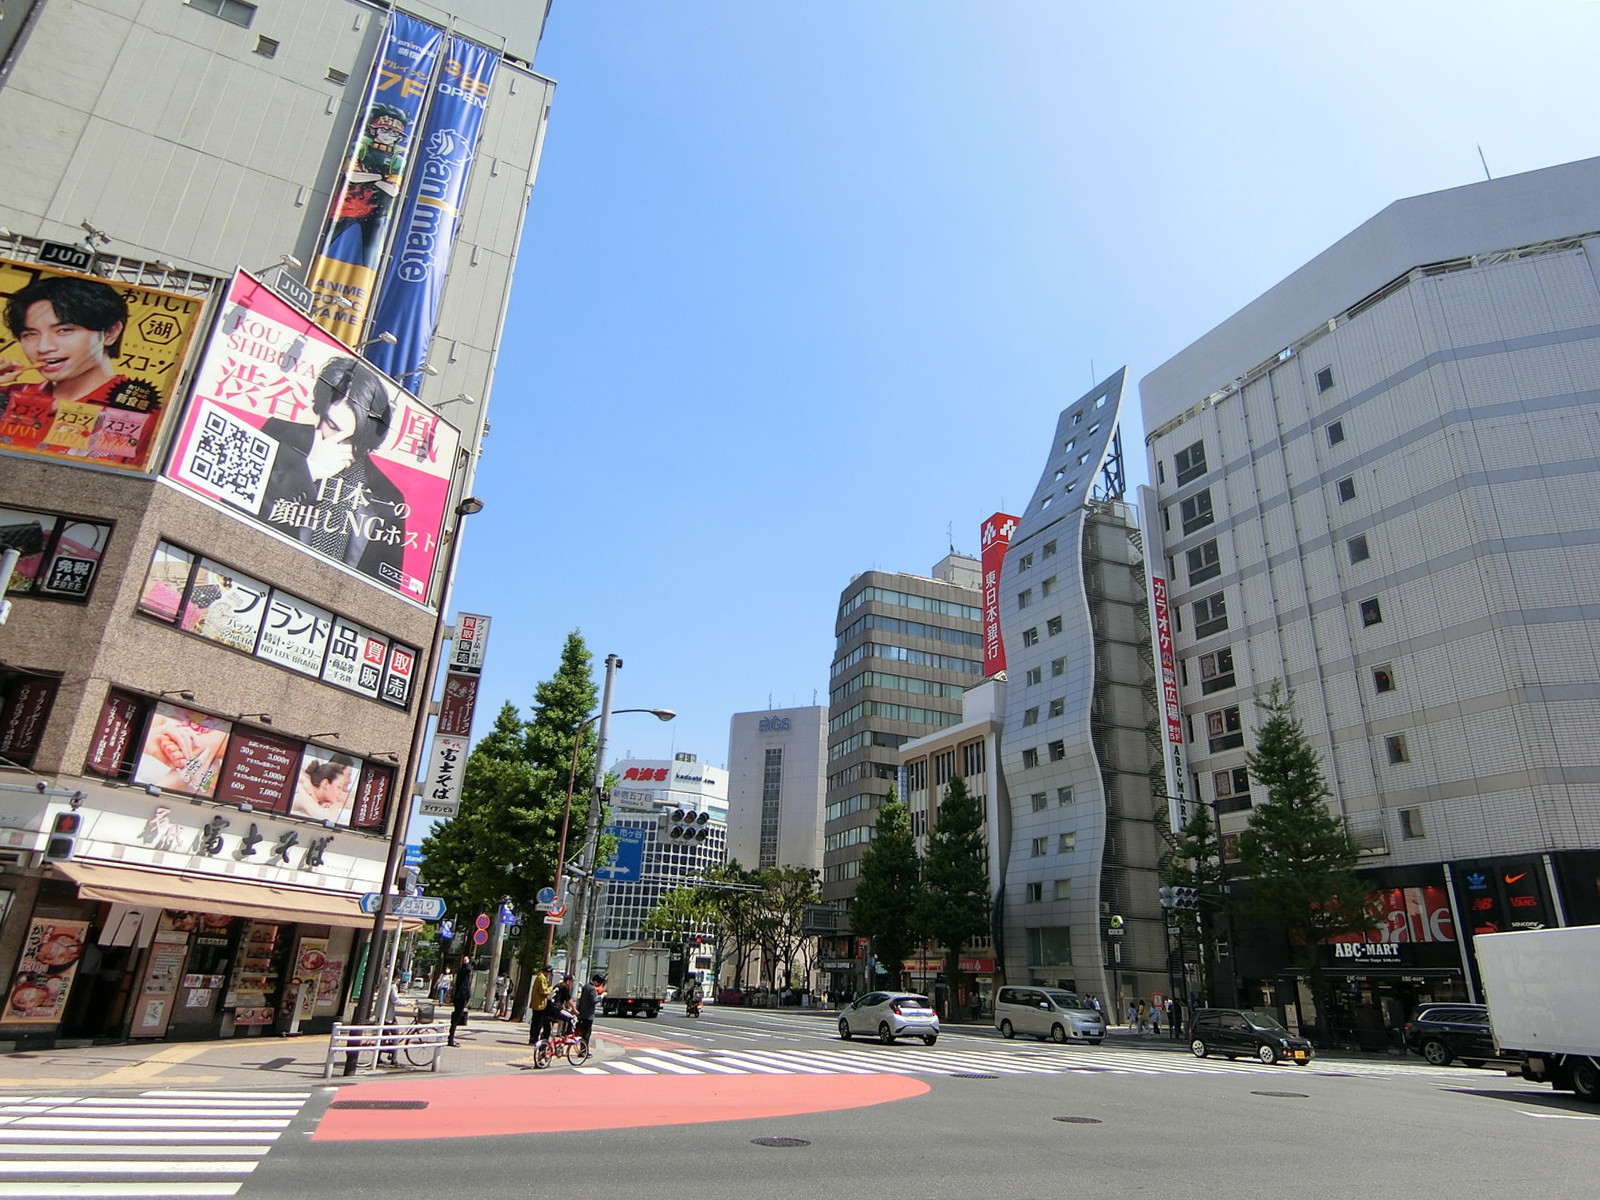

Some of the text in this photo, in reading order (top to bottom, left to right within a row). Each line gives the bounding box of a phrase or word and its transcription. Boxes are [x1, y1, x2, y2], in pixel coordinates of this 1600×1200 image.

[378, 69, 426, 98] 7F
[438, 83, 487, 109] OPEN
[398, 161, 458, 283] animate
[315, 278, 366, 300] ANIME
[312, 291, 363, 312] COC
[146, 319, 173, 339] 湖
[234, 313, 282, 346] KOU
[118, 352, 175, 374] スコーン
[226, 332, 316, 380] SHIBUYA
[213, 354, 309, 422] 渋谷
[11, 403, 49, 418] スコーン
[57, 411, 95, 427] スコーン
[105, 419, 141, 434] スコーン
[316, 475, 411, 521] 日本一の
[268, 497, 438, 555] 顔出しNGホスト
[56, 559, 91, 576] 免税
[56, 573, 83, 584] TAX
[53, 580, 82, 591] FREE
[984, 570, 999, 660] 東日本銀行
[233, 585, 410, 675] ブランド品 買取
[275, 648, 290, 660] LUX
[292, 655, 319, 672] BRAND
[360, 666, 405, 699] 販売
[1169, 732, 1181, 741] 5F
[432, 747, 460, 800] 富士そば
[612, 789, 653, 803] 新宿五丁目
[1510, 896, 1537, 907] VANS
[1335, 942, 1399, 958] ABC-MART
